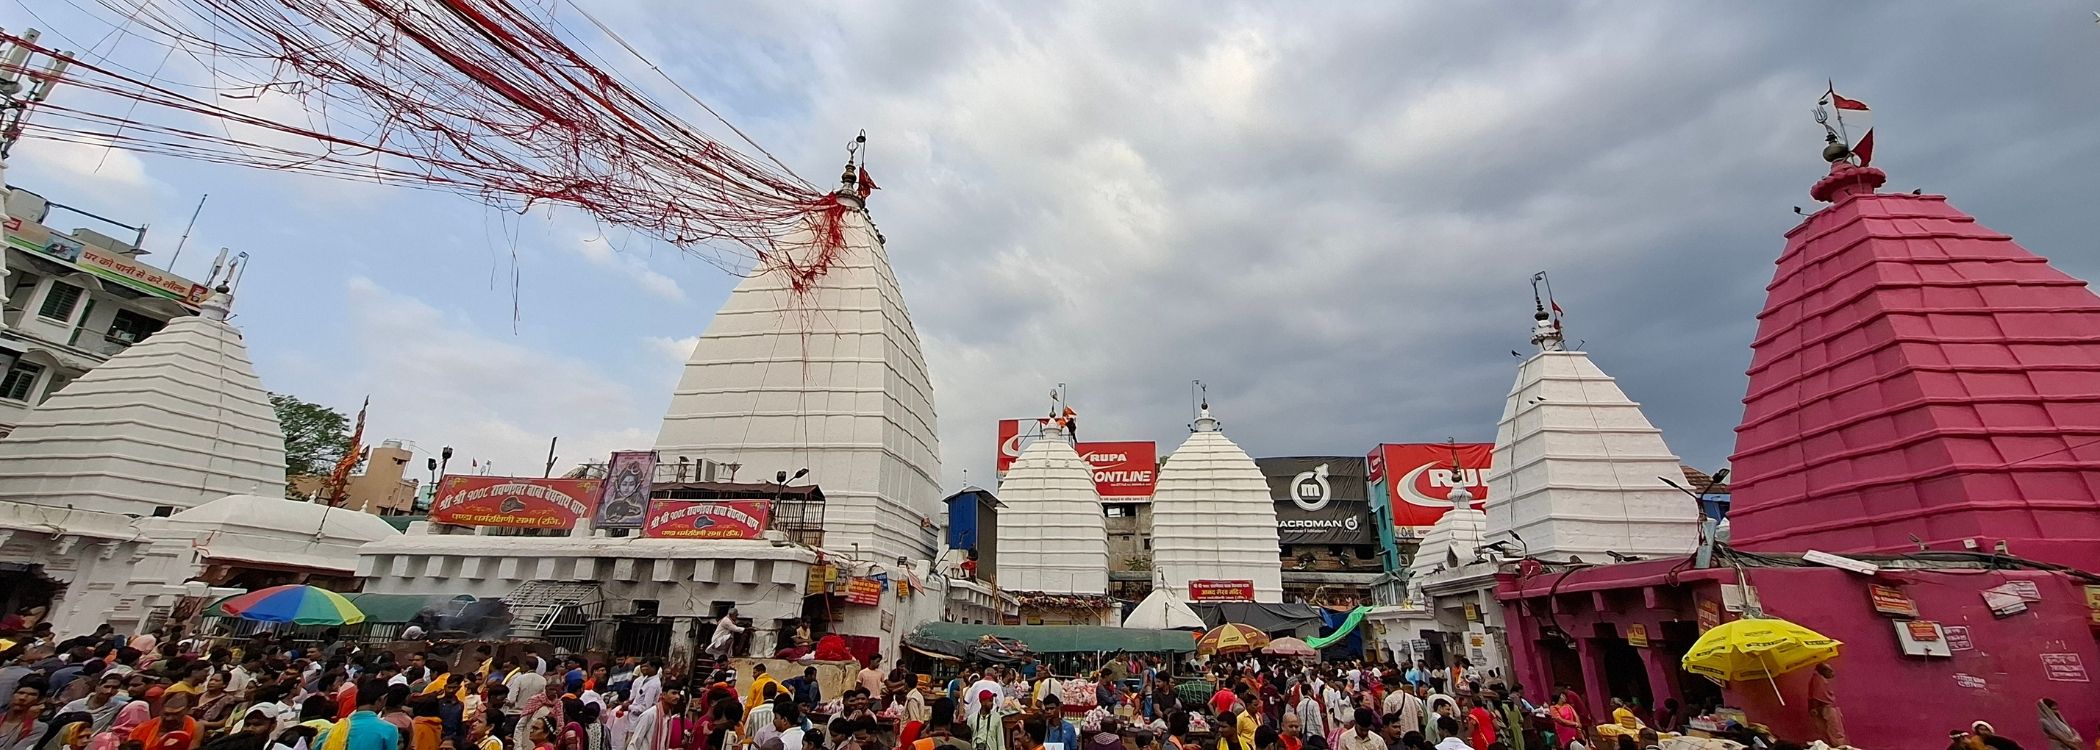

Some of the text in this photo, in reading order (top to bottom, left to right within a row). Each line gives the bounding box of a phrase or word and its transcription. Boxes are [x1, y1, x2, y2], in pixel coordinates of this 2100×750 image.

[84, 251, 97, 262] घर
[99, 258, 113, 268] को
[115, 263, 136, 275] पानी
[1090, 453, 1127, 462] RUPA
[1092, 470, 1152, 483] ONTLINE
[440, 495, 452, 511] श्री
[453, 490, 466, 505] श्री
